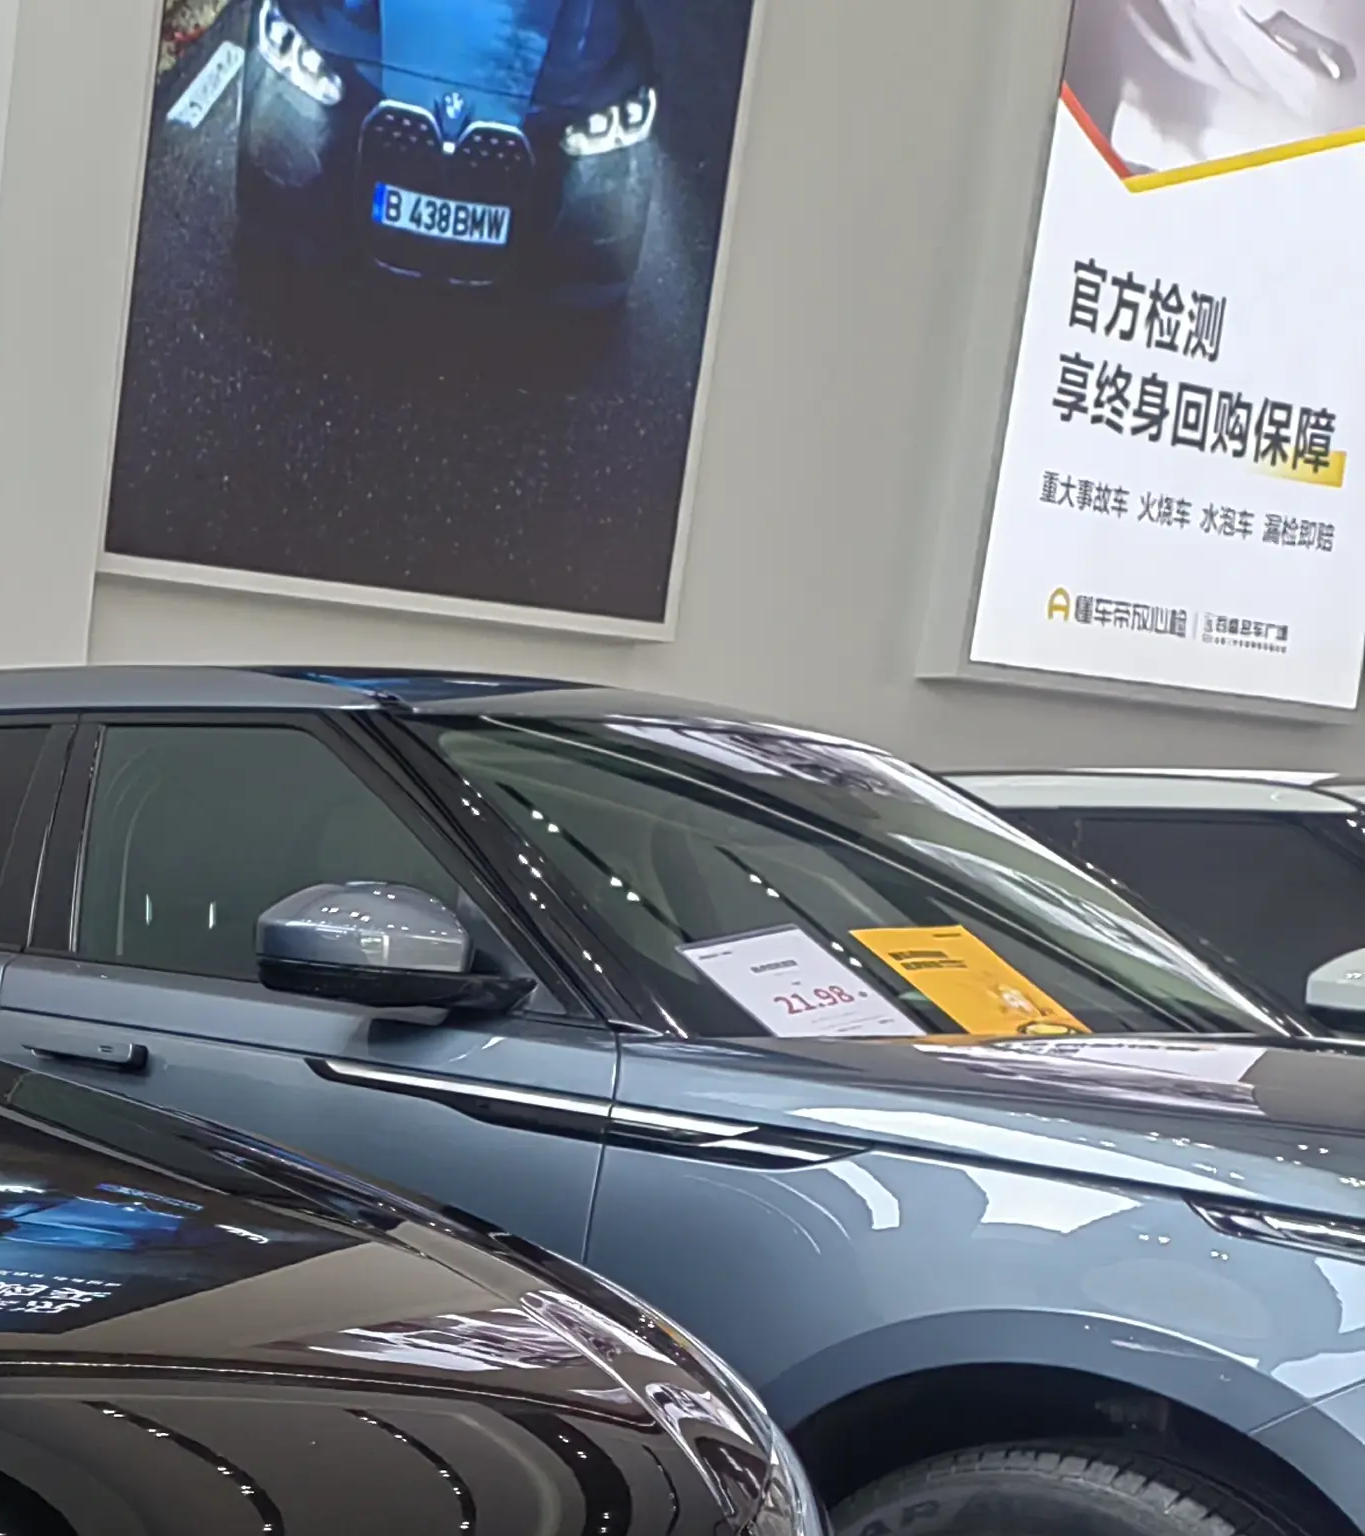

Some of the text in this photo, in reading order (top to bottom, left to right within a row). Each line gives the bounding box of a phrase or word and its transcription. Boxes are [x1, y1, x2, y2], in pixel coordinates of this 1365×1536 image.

[384, 190, 506, 240] B 438BMW
[1067, 257, 1227, 364] 官方检测
[1051, 351, 1337, 475] 享终身回购保障
[1039, 470, 1336, 552] 重大事故车 火烧车 水泡车 漏检即赔
[773, 985, 856, 1015] 21.98
